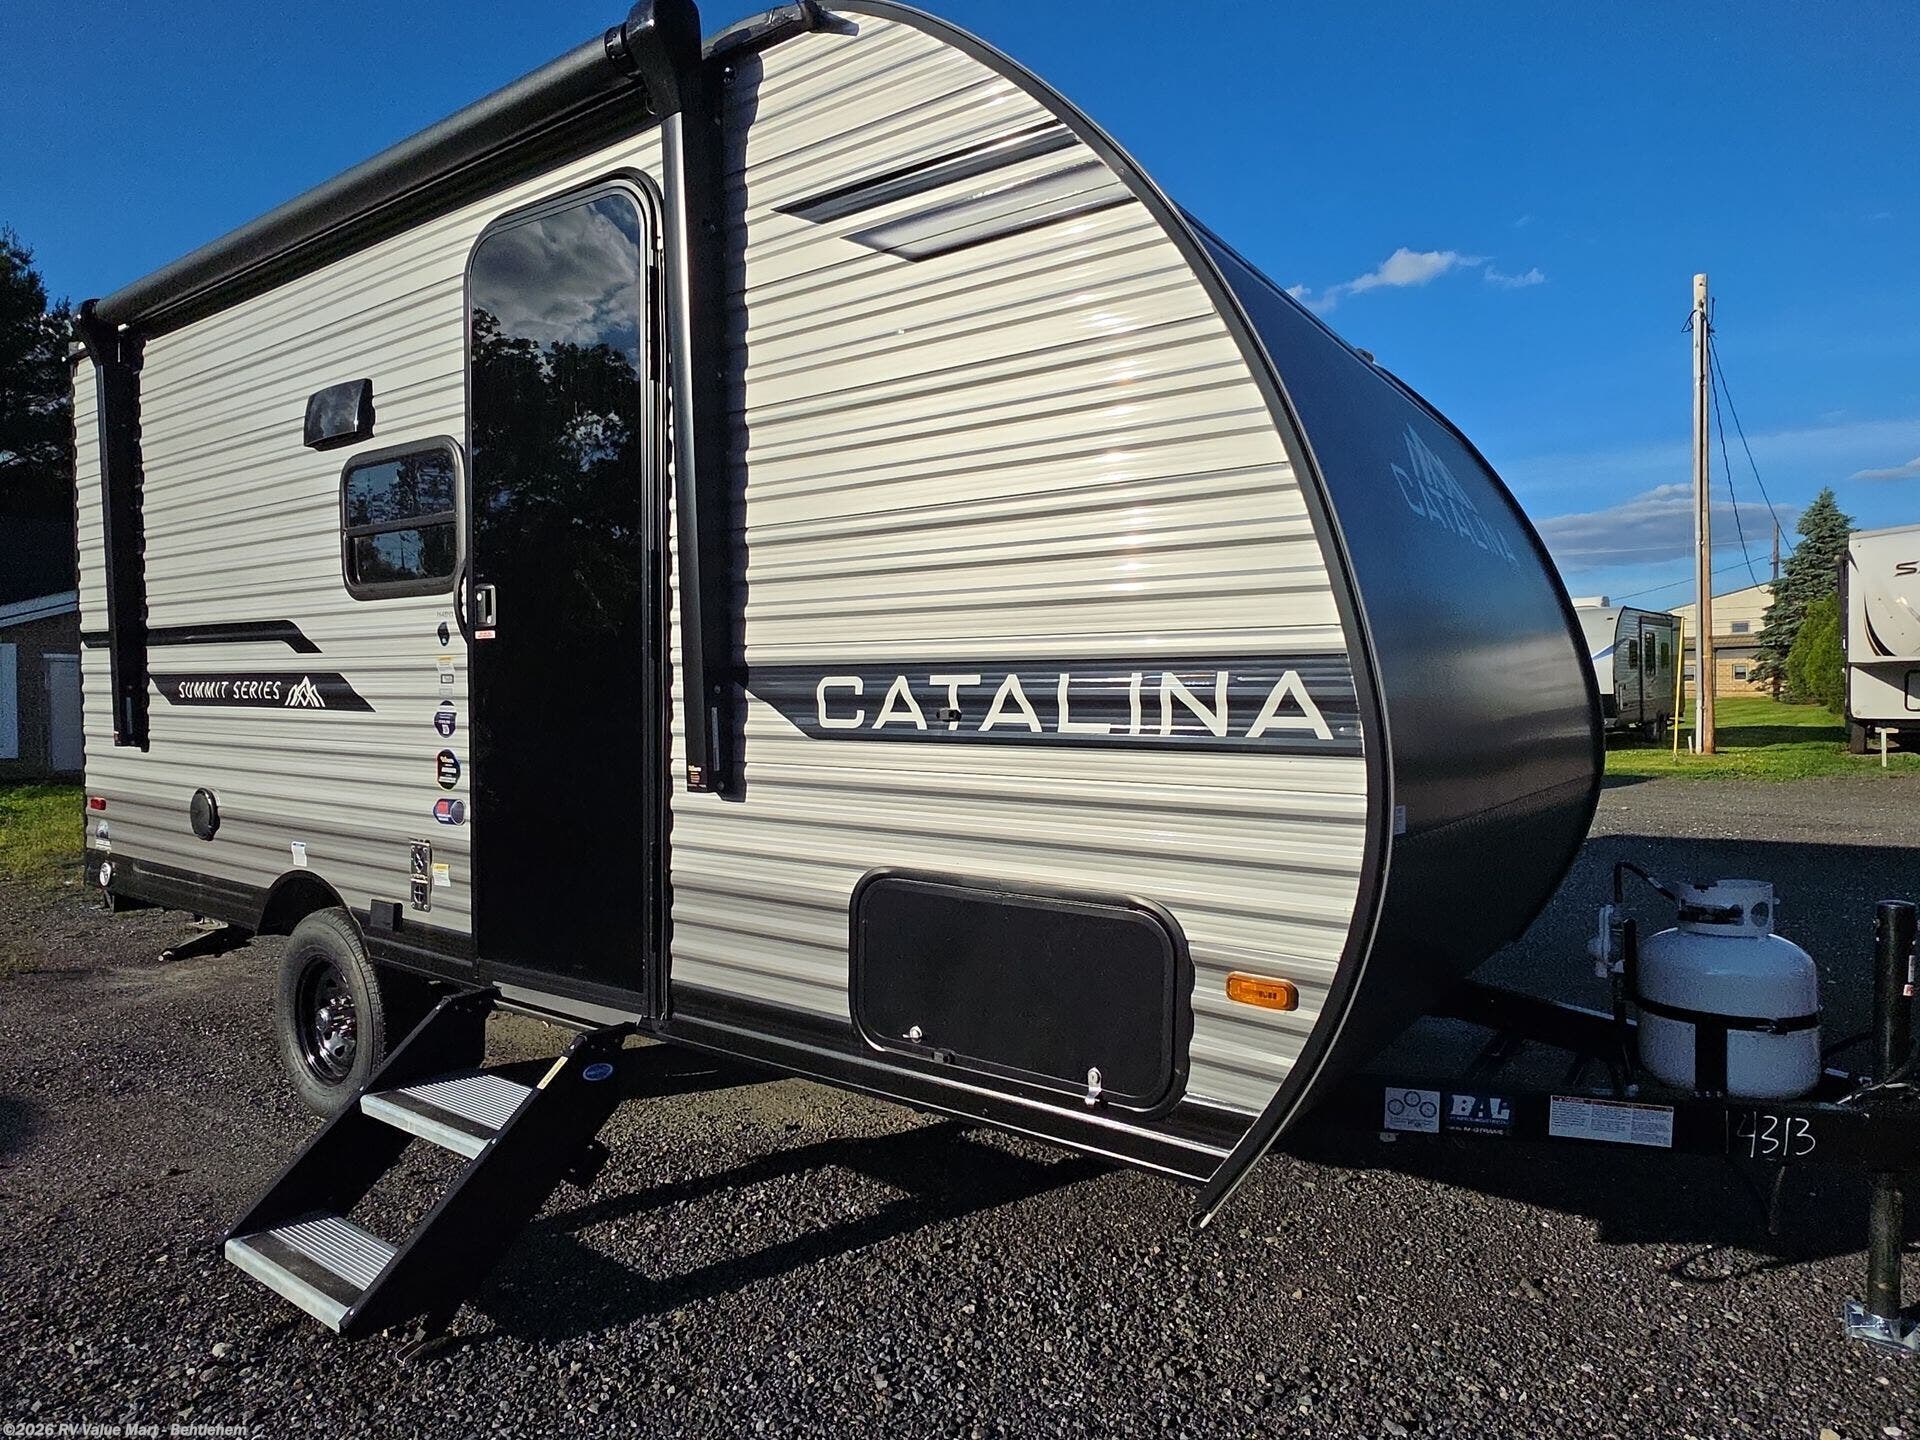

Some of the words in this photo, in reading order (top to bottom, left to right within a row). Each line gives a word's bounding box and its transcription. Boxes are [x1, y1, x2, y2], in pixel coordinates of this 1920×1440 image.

[178, 681, 227, 699] SUMMIT
[233, 681, 282, 700] SERIES
[816, 670, 1334, 741] CATALINA
